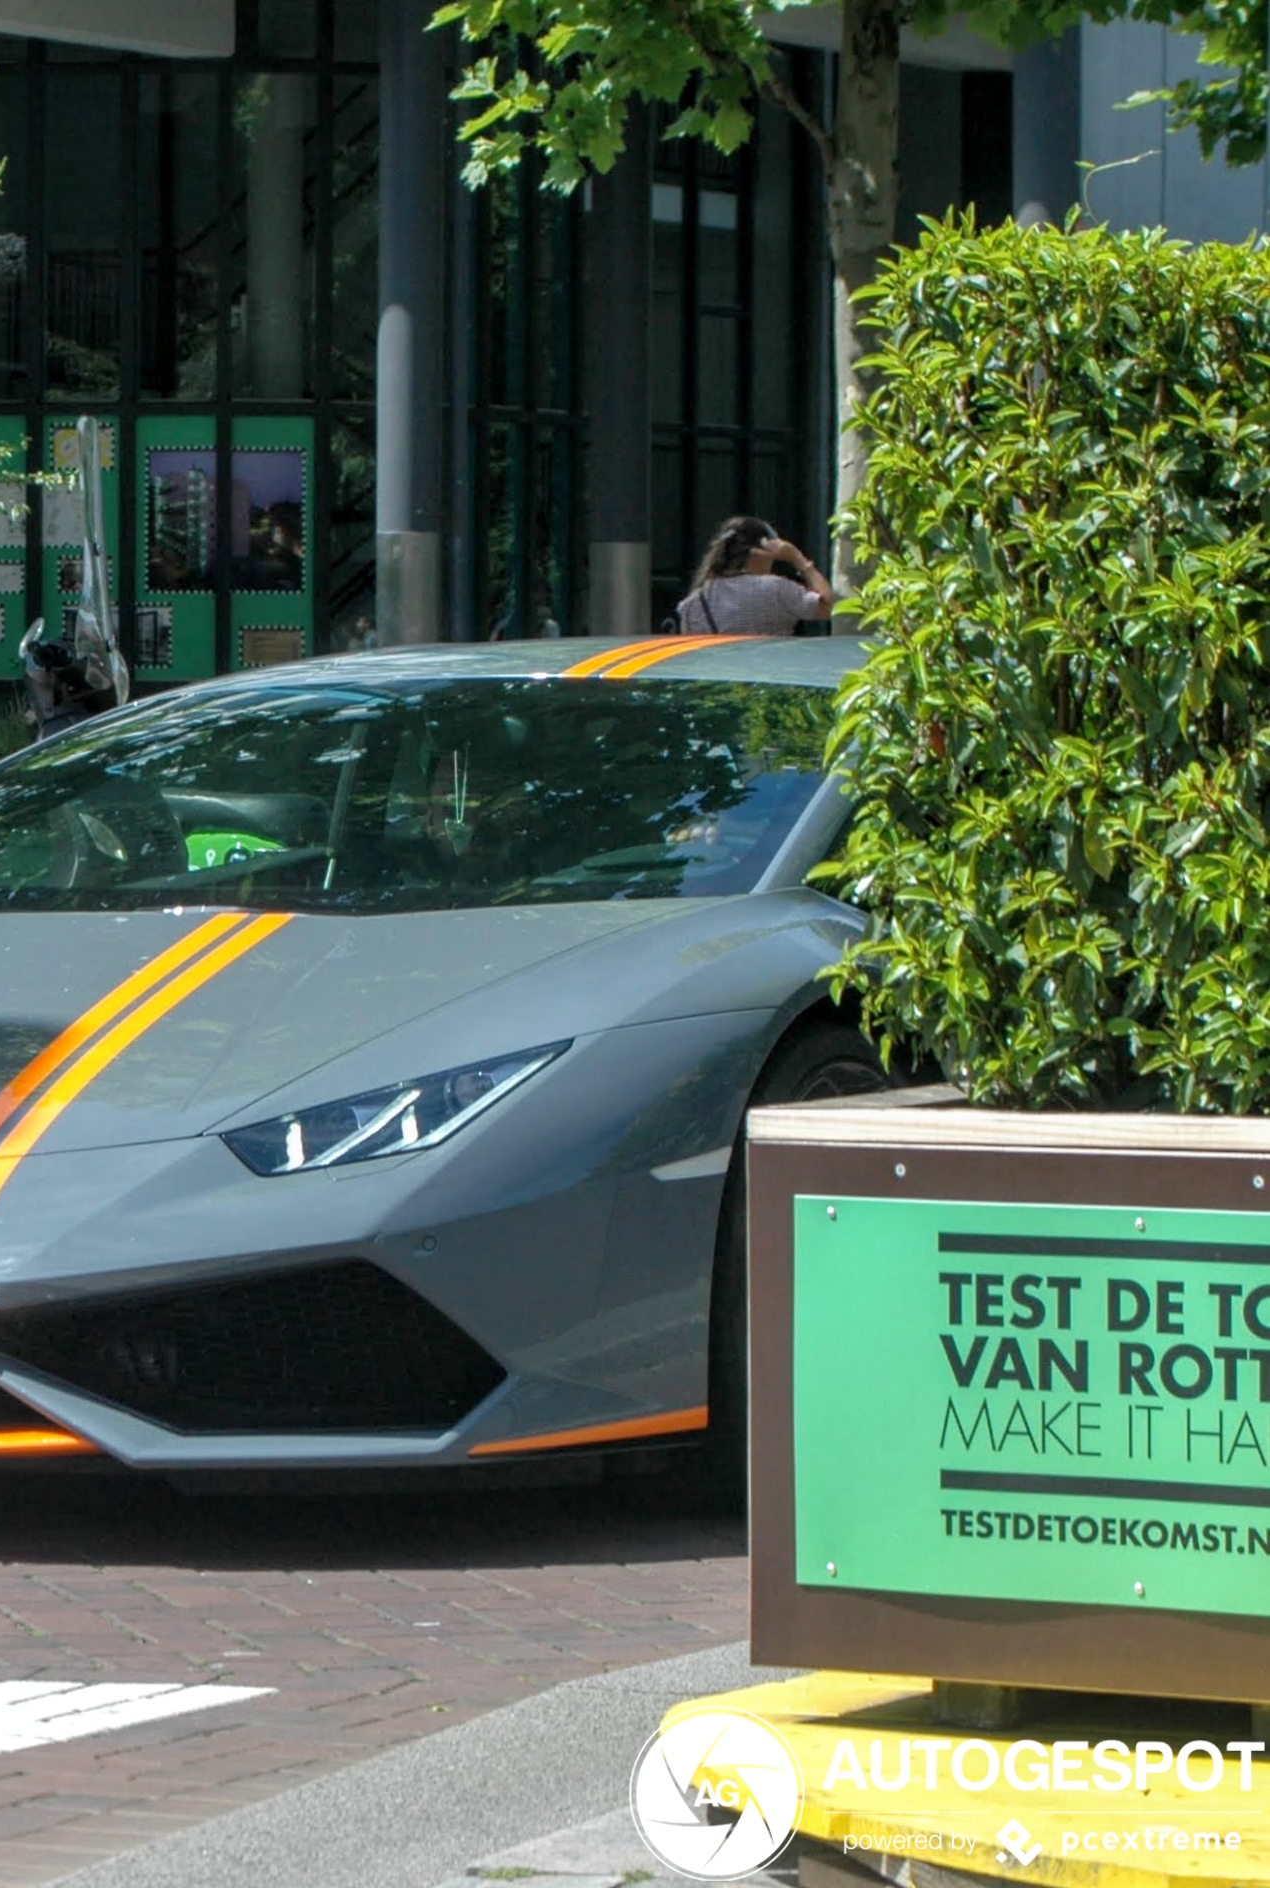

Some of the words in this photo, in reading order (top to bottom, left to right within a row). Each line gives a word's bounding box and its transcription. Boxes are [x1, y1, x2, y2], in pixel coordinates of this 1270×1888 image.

[939, 1272, 1082, 1330] TEST
[1107, 1278, 1185, 1335] DE
[939, 1334, 1089, 1394] VAN
[1119, 1342, 1270, 1403] ROTT
[940, 1397, 1101, 1457] MAKE
[1129, 1405, 1163, 1460] IT
